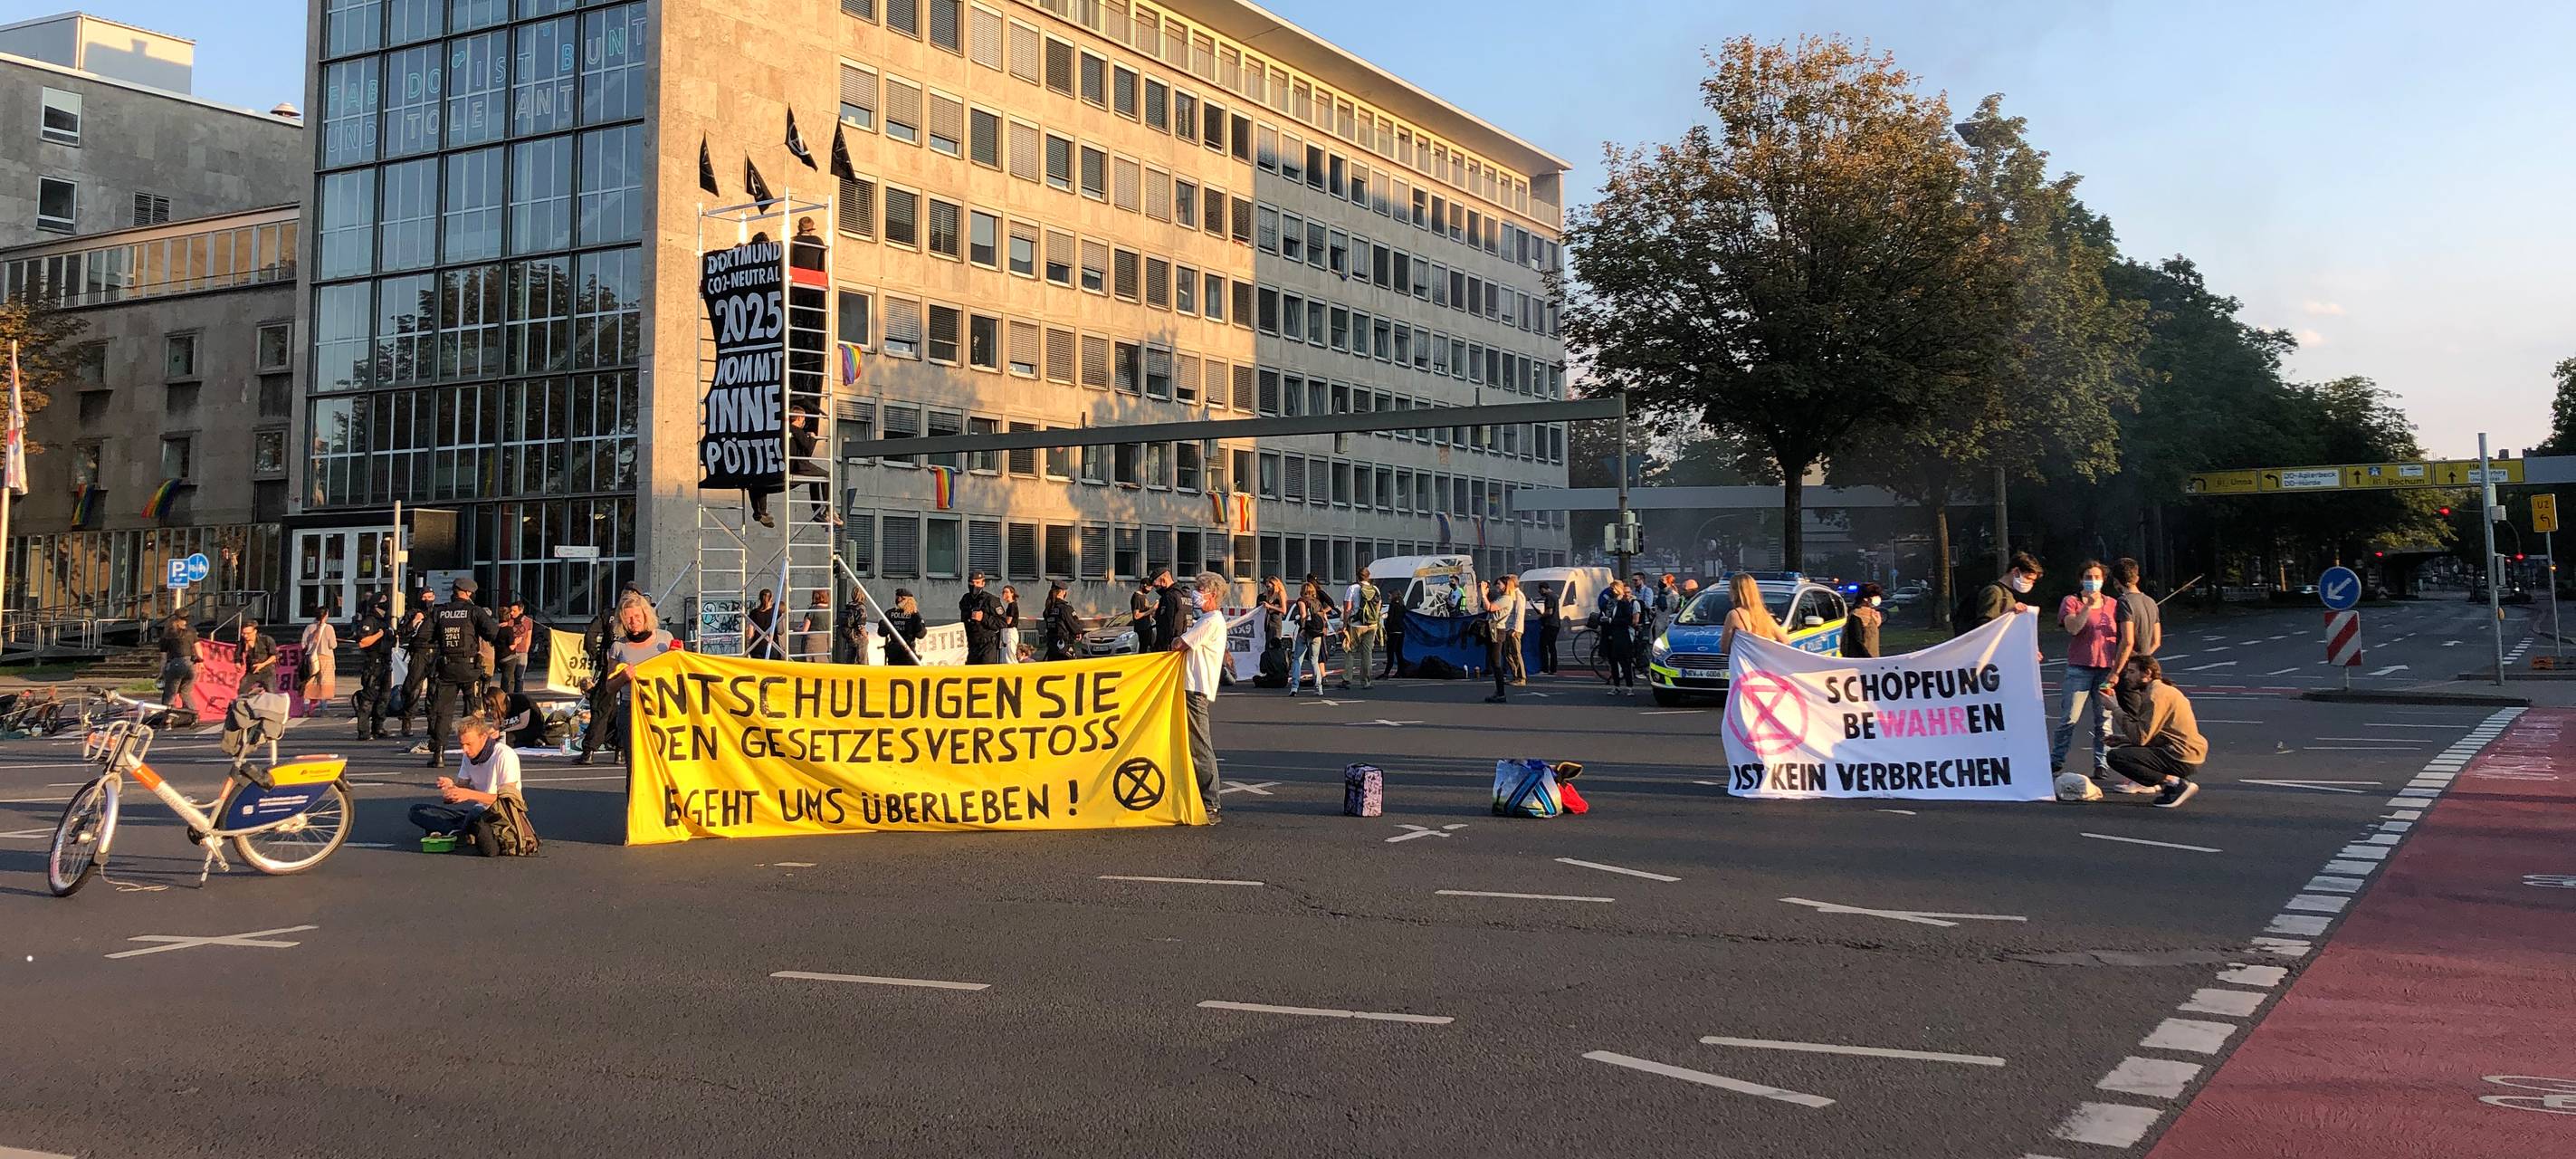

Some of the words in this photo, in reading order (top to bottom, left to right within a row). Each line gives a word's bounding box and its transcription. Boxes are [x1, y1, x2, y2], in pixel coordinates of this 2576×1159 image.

[561, 18, 646, 72] BUNT
[326, 120, 377, 153] UND
[707, 242, 782, 274] DORTMUND
[707, 266, 781, 295] CO2-NEUTRAL
[715, 291, 783, 344] 2025
[709, 385, 782, 434] INNE
[706, 436, 785, 475] PÖTTE!
[2387, 477, 2425, 485] Bochum
[2537, 501, 2550, 509] U2
[172, 561, 186, 577] P
[440, 609, 468, 618] POLIZEI
[639, 674, 1023, 719] ENTSCHULDIGEN
[1036, 671, 1122, 719] SIE
[1826, 664, 2000, 704] SCHÖPFUNG
[651, 725, 718, 761] DEN
[741, 714, 1121, 764] GESETZESVERSTOSS
[1843, 703, 2006, 740] BEWAHREN
[1733, 763, 1764, 790] IST
[1770, 762, 1827, 790] KEIN
[1835, 757, 2012, 791] VERBRECHEN
[778, 787, 845, 824] UMS
